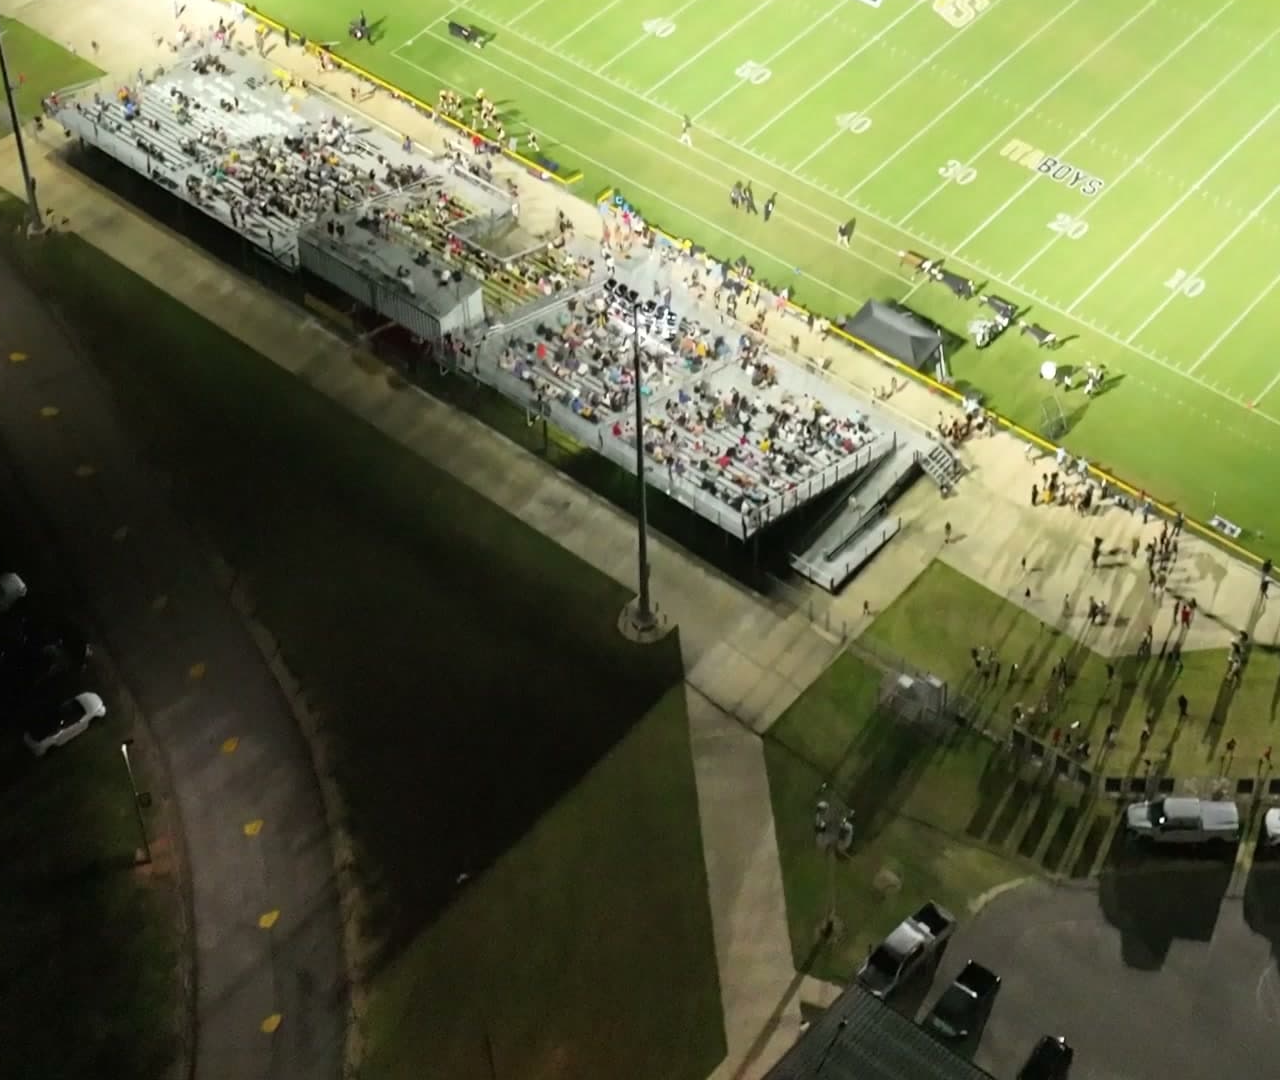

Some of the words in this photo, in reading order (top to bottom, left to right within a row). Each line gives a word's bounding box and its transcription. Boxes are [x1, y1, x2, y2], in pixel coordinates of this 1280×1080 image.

[938, 159, 977, 185] 30
[1046, 213, 1089, 240] 20
[1164, 268, 1206, 297] 10
